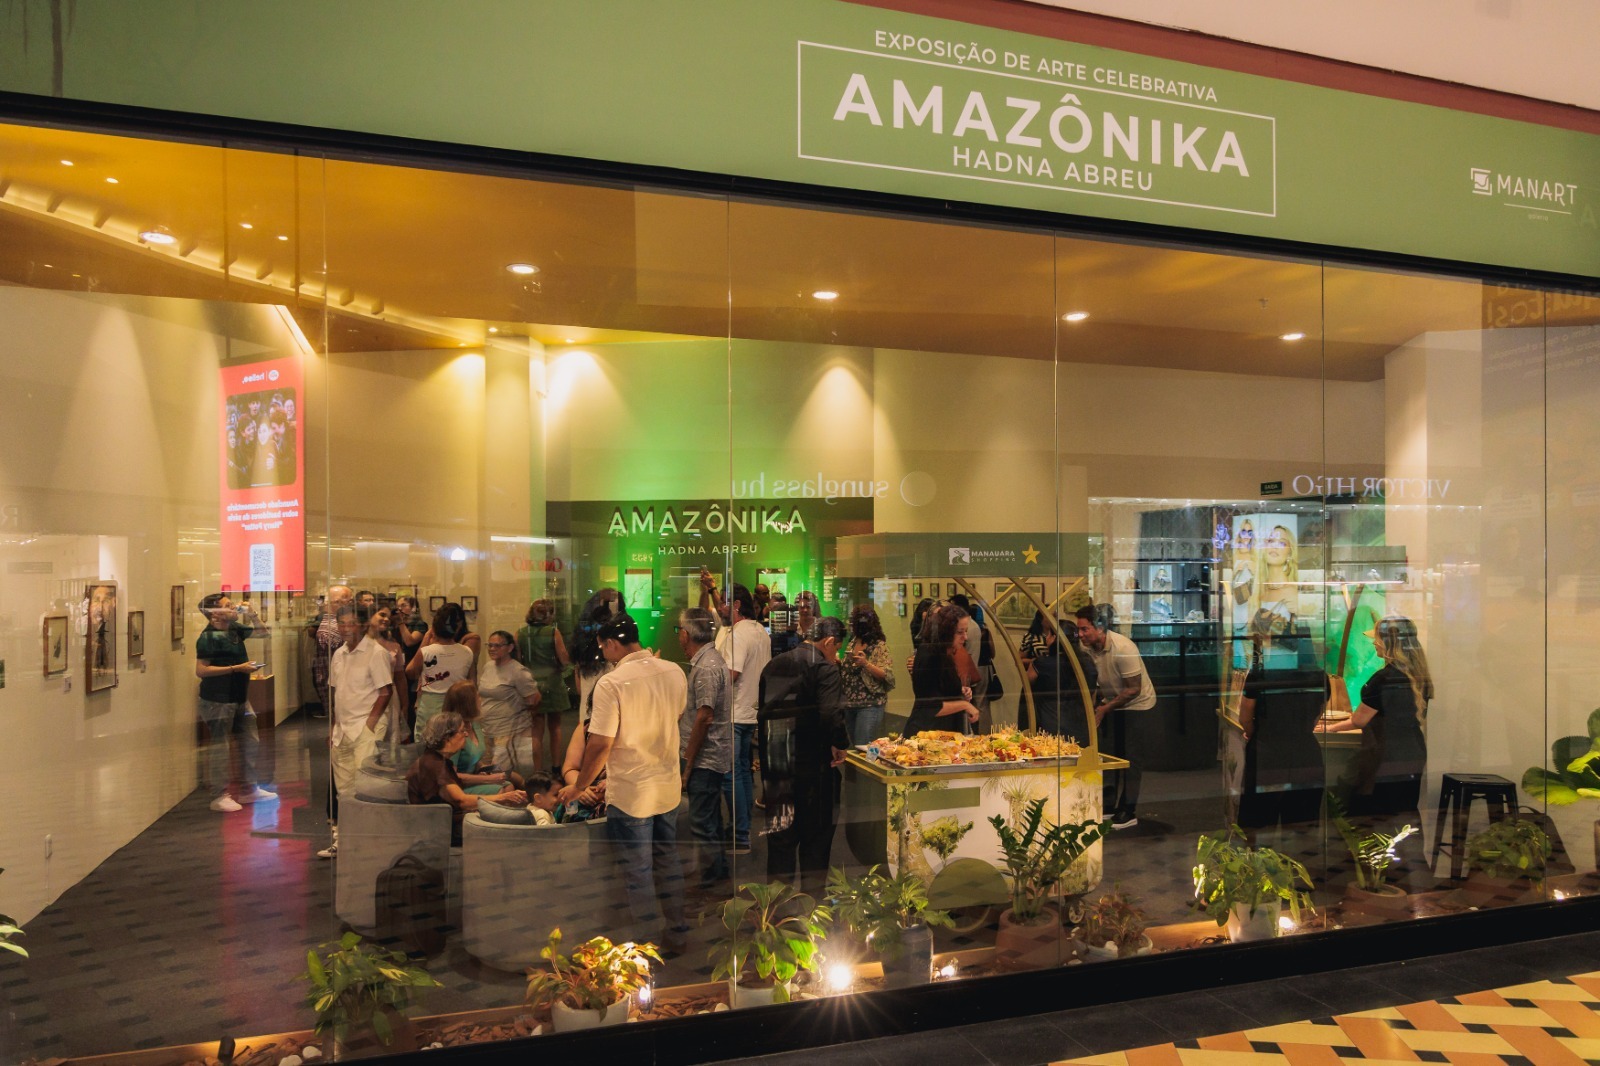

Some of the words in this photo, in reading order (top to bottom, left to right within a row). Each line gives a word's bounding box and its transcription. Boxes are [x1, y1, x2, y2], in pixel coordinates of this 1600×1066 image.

[874, 30, 997, 65] EXPOSIÇÃO
[1004, 51, 1031, 72] DE
[1036, 58, 1087, 80] ARTE
[1092, 67, 1218, 103] CELEBRATIVA
[833, 72, 1250, 178] AMAZÔNIKA
[953, 146, 1054, 180] HADNA
[1063, 161, 1153, 191] ABREU
[1497, 173, 1578, 206] MANART
[608, 504, 807, 534] AMAZÔNIKA
[658, 544, 706, 556] HADNA
[711, 544, 758, 555] ABREU
